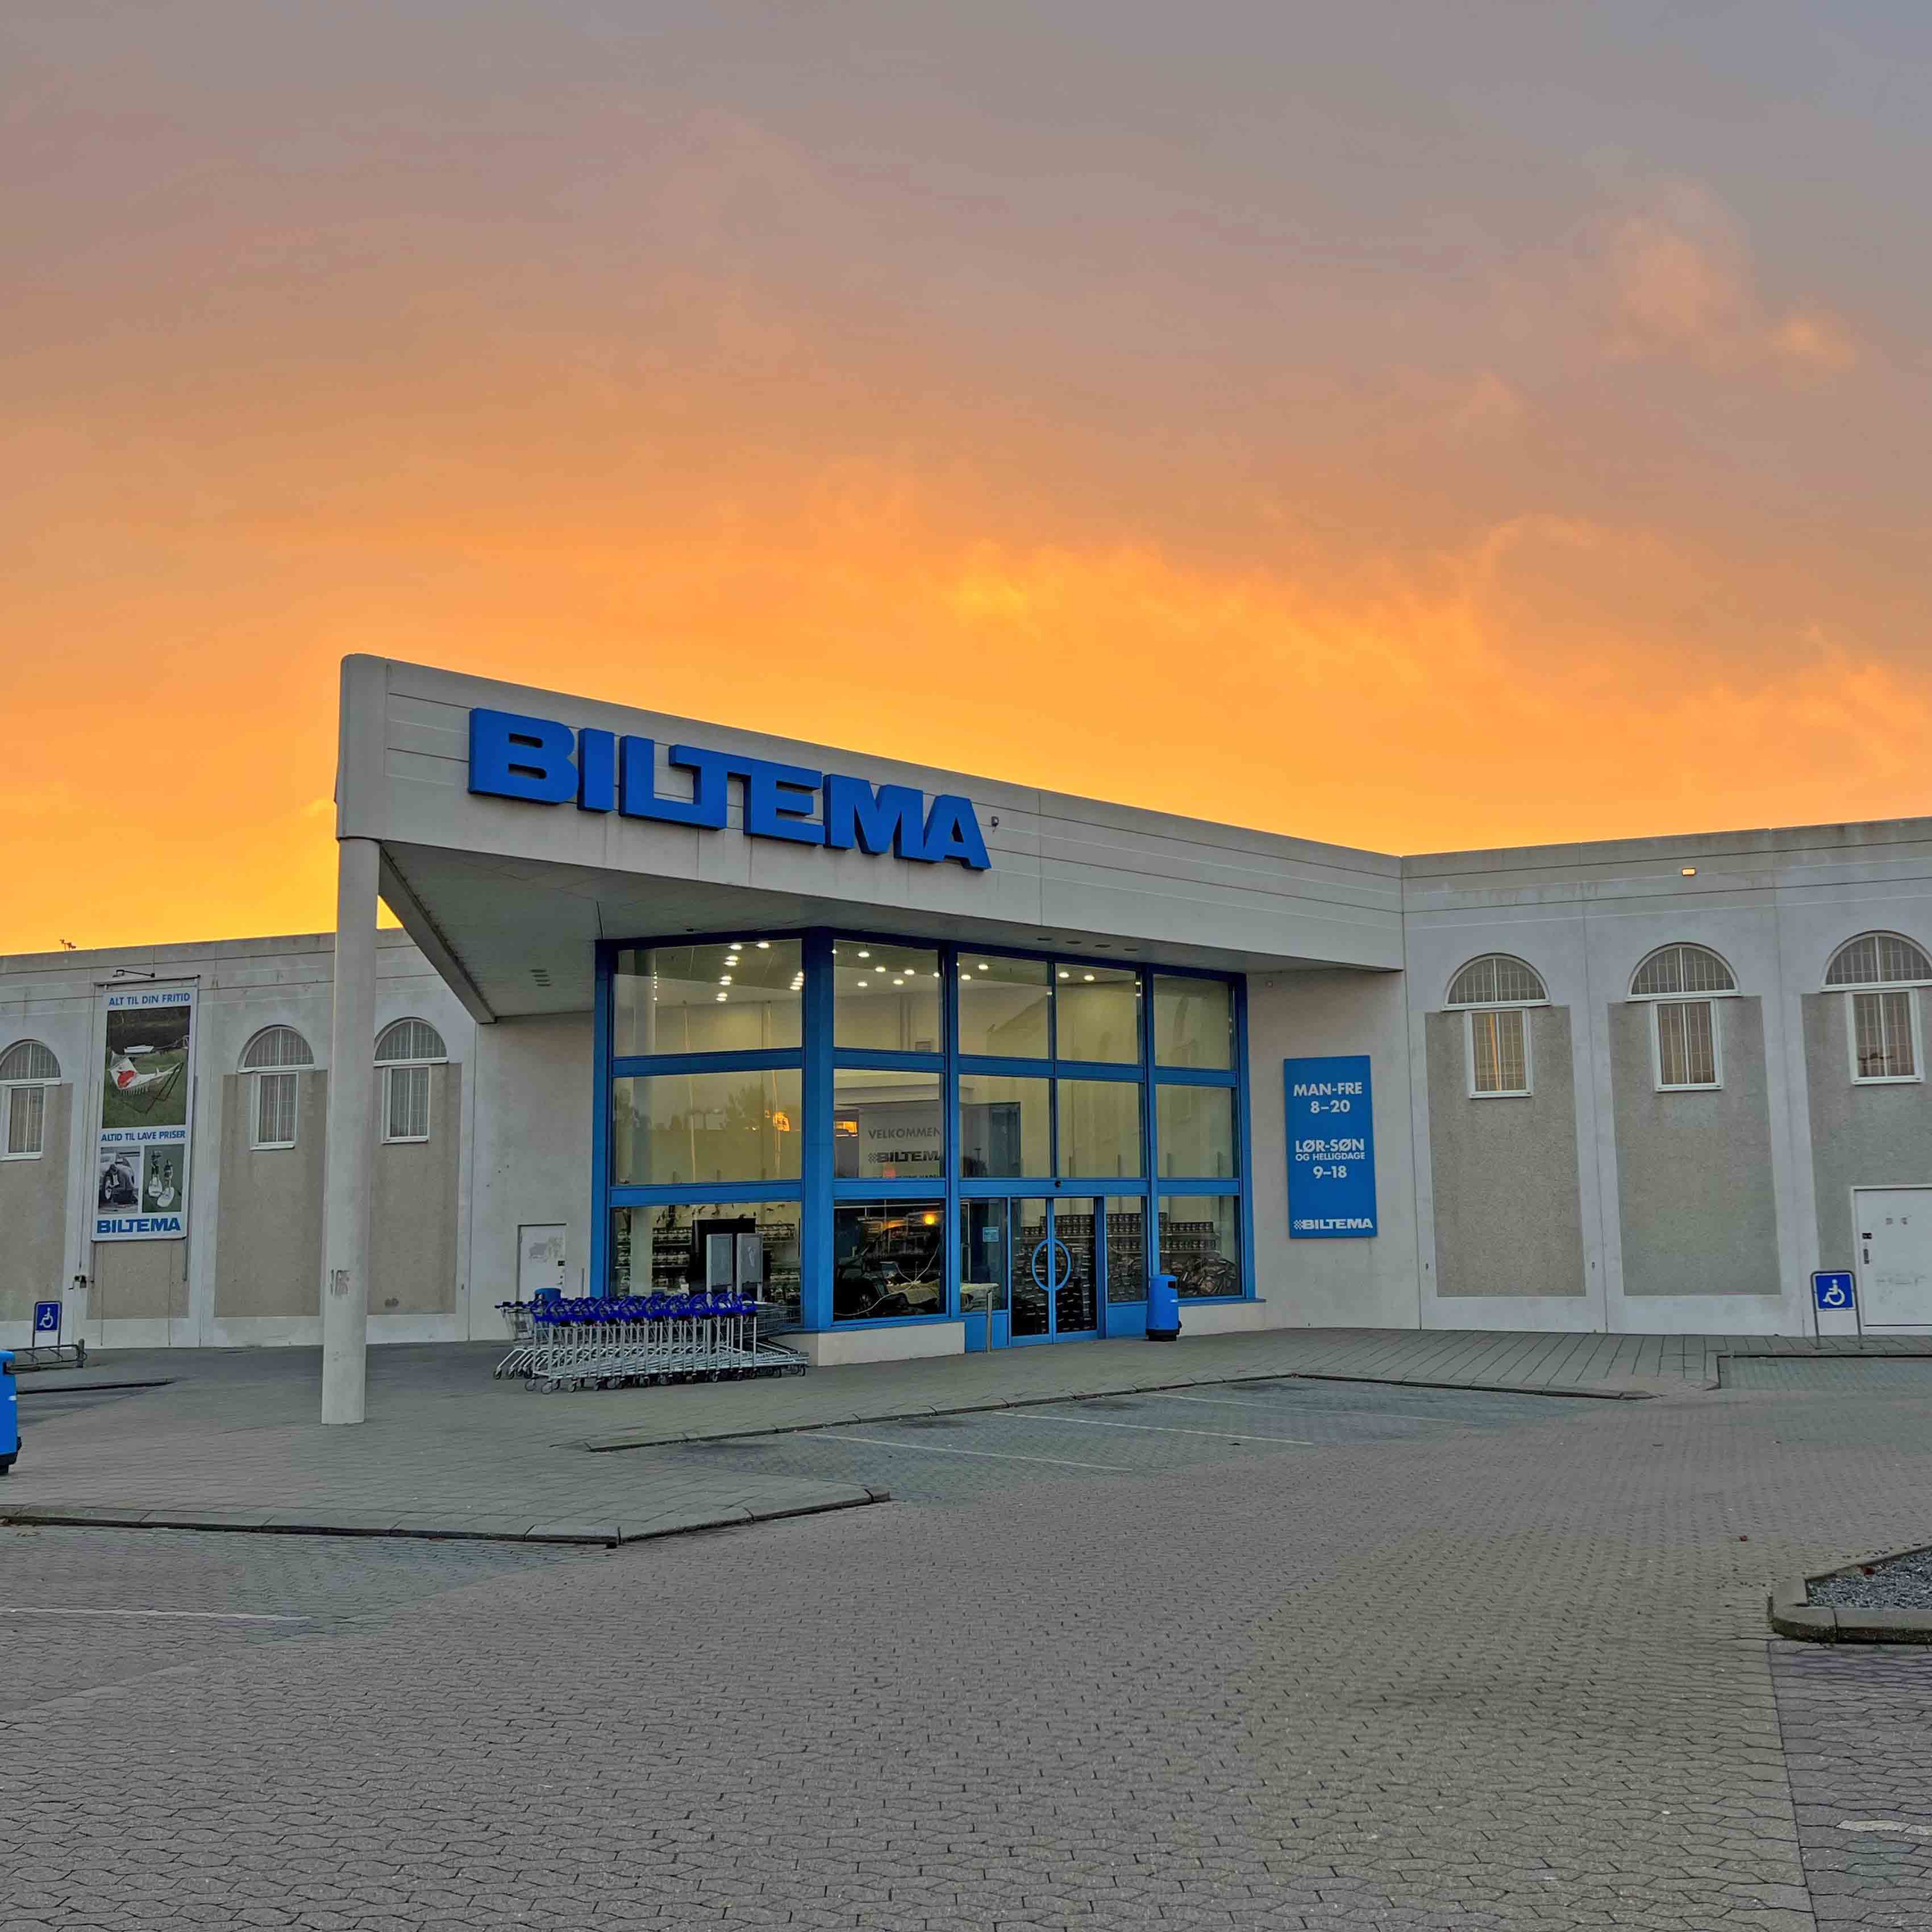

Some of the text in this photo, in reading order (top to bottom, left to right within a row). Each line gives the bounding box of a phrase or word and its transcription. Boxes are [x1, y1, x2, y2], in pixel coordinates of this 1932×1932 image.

[468, 707, 992, 871] BILTEMA
[109, 993, 190, 1006] ALT TIL DIN FRITID
[1293, 1082, 1362, 1097] MAN-FRE
[101, 1130, 185, 1142] ALTID TIL LAVE PRISER
[868, 1127, 941, 1139] VELKOMMEN
[1296, 1138, 1364, 1153] LØR-SØN
[1313, 1152, 1365, 1161] HELLIGDAGE
[97, 1217, 181, 1233] BILTEMA
[1302, 1218, 1373, 1230] BILTEMA
